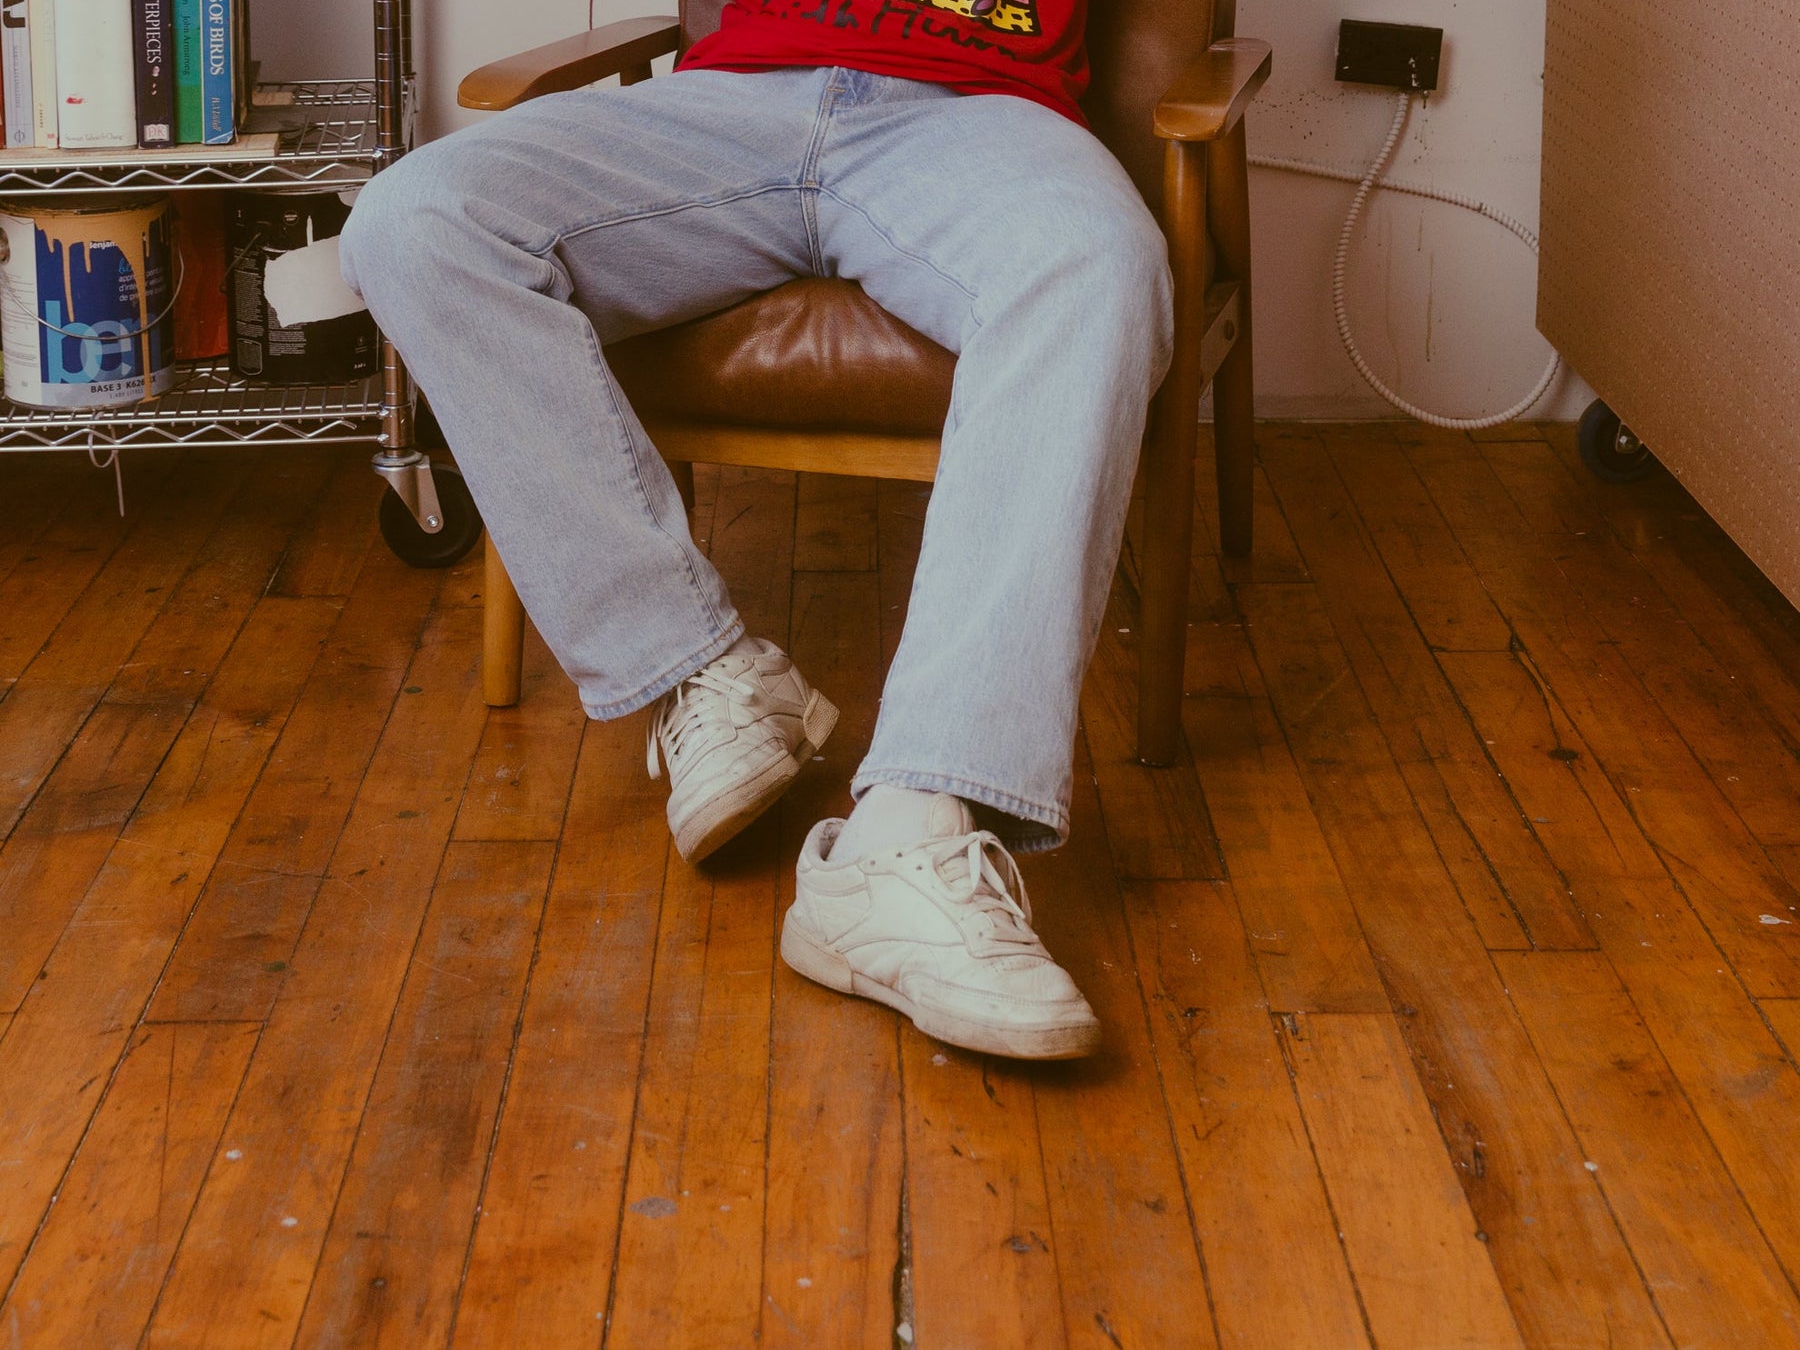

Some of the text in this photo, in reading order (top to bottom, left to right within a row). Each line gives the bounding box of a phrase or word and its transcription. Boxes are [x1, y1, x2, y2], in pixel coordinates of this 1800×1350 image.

[181, 15, 191, 33] John
[208, 3, 224, 25] OF
[182, 35, 192, 76] Armstrong
[209, 27, 225, 76] BIRDS
[90, 384, 115, 394] BASE
[115, 383, 122, 392] 3
